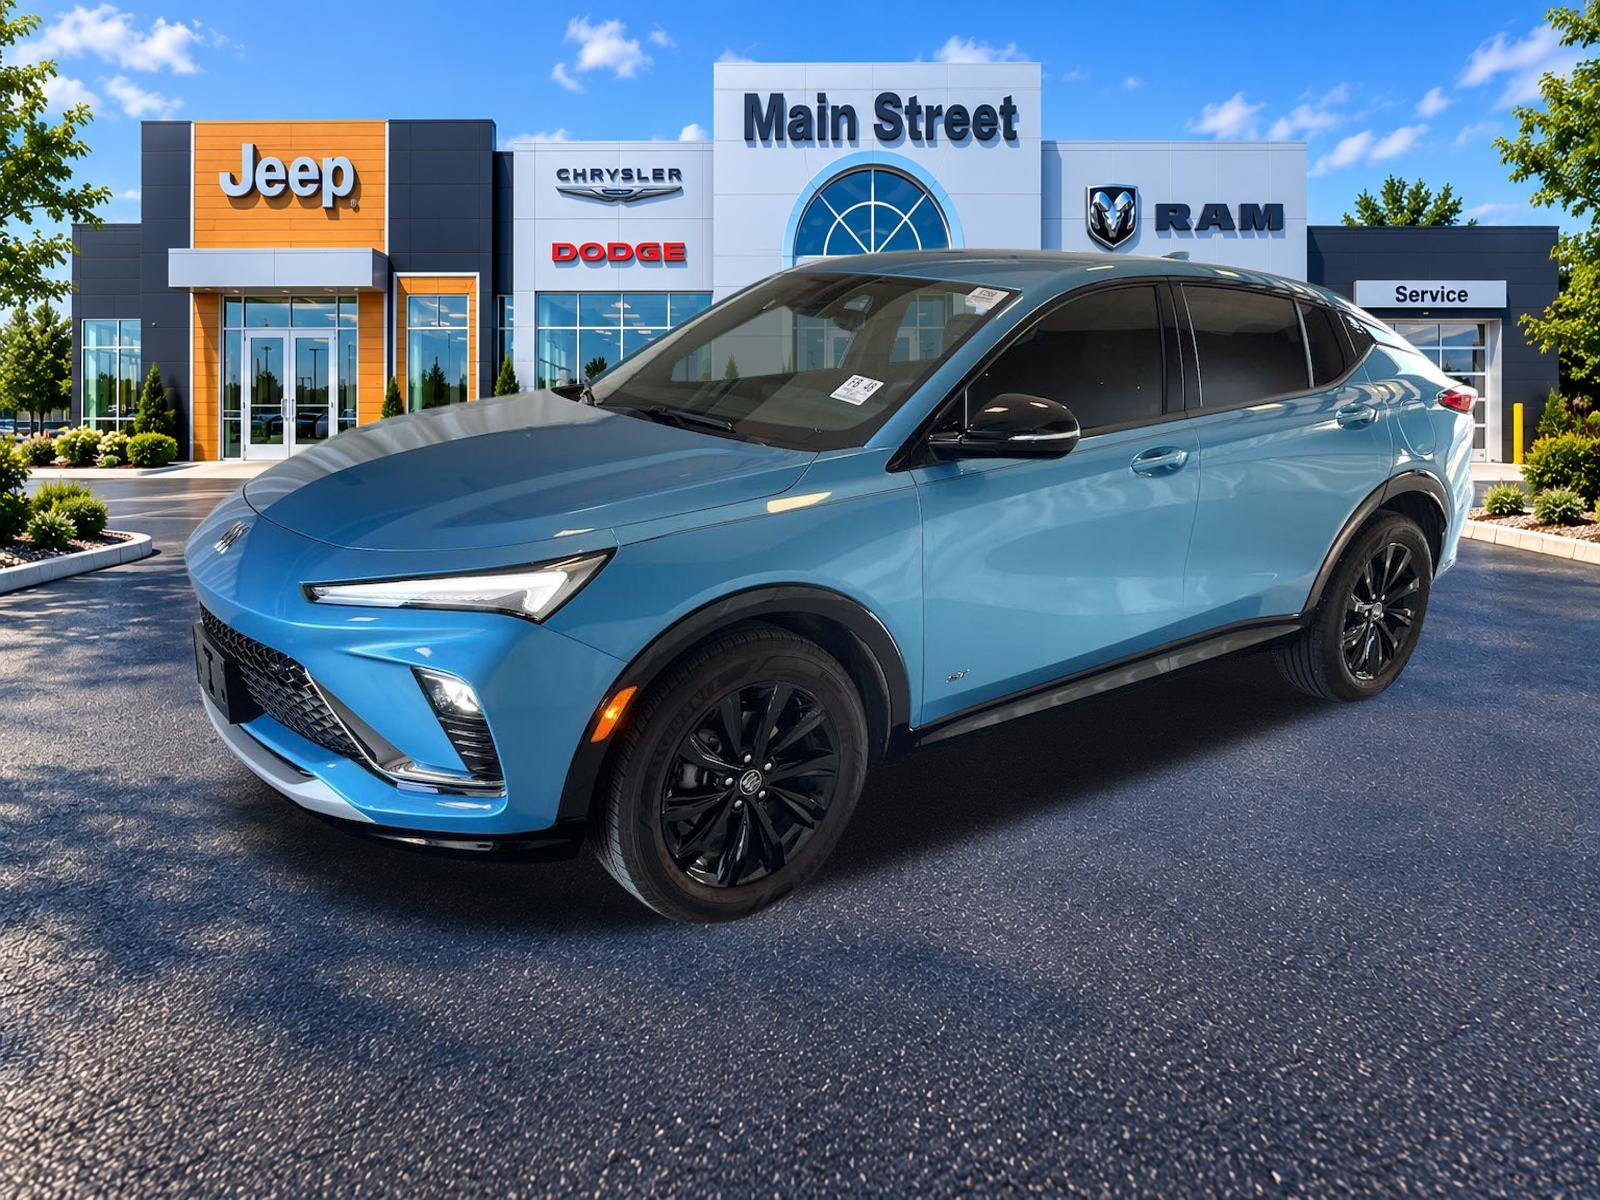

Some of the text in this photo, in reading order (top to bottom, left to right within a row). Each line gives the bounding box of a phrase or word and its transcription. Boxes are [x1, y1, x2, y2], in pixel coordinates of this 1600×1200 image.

[744, 92, 1018, 141] Main Street
[219, 143, 355, 208] Jeep
[556, 168, 683, 182] CHRYSLER
[1155, 203, 1284, 231] RAM
[552, 242, 687, 262] DODGE
[1395, 285, 1469, 303] Service
